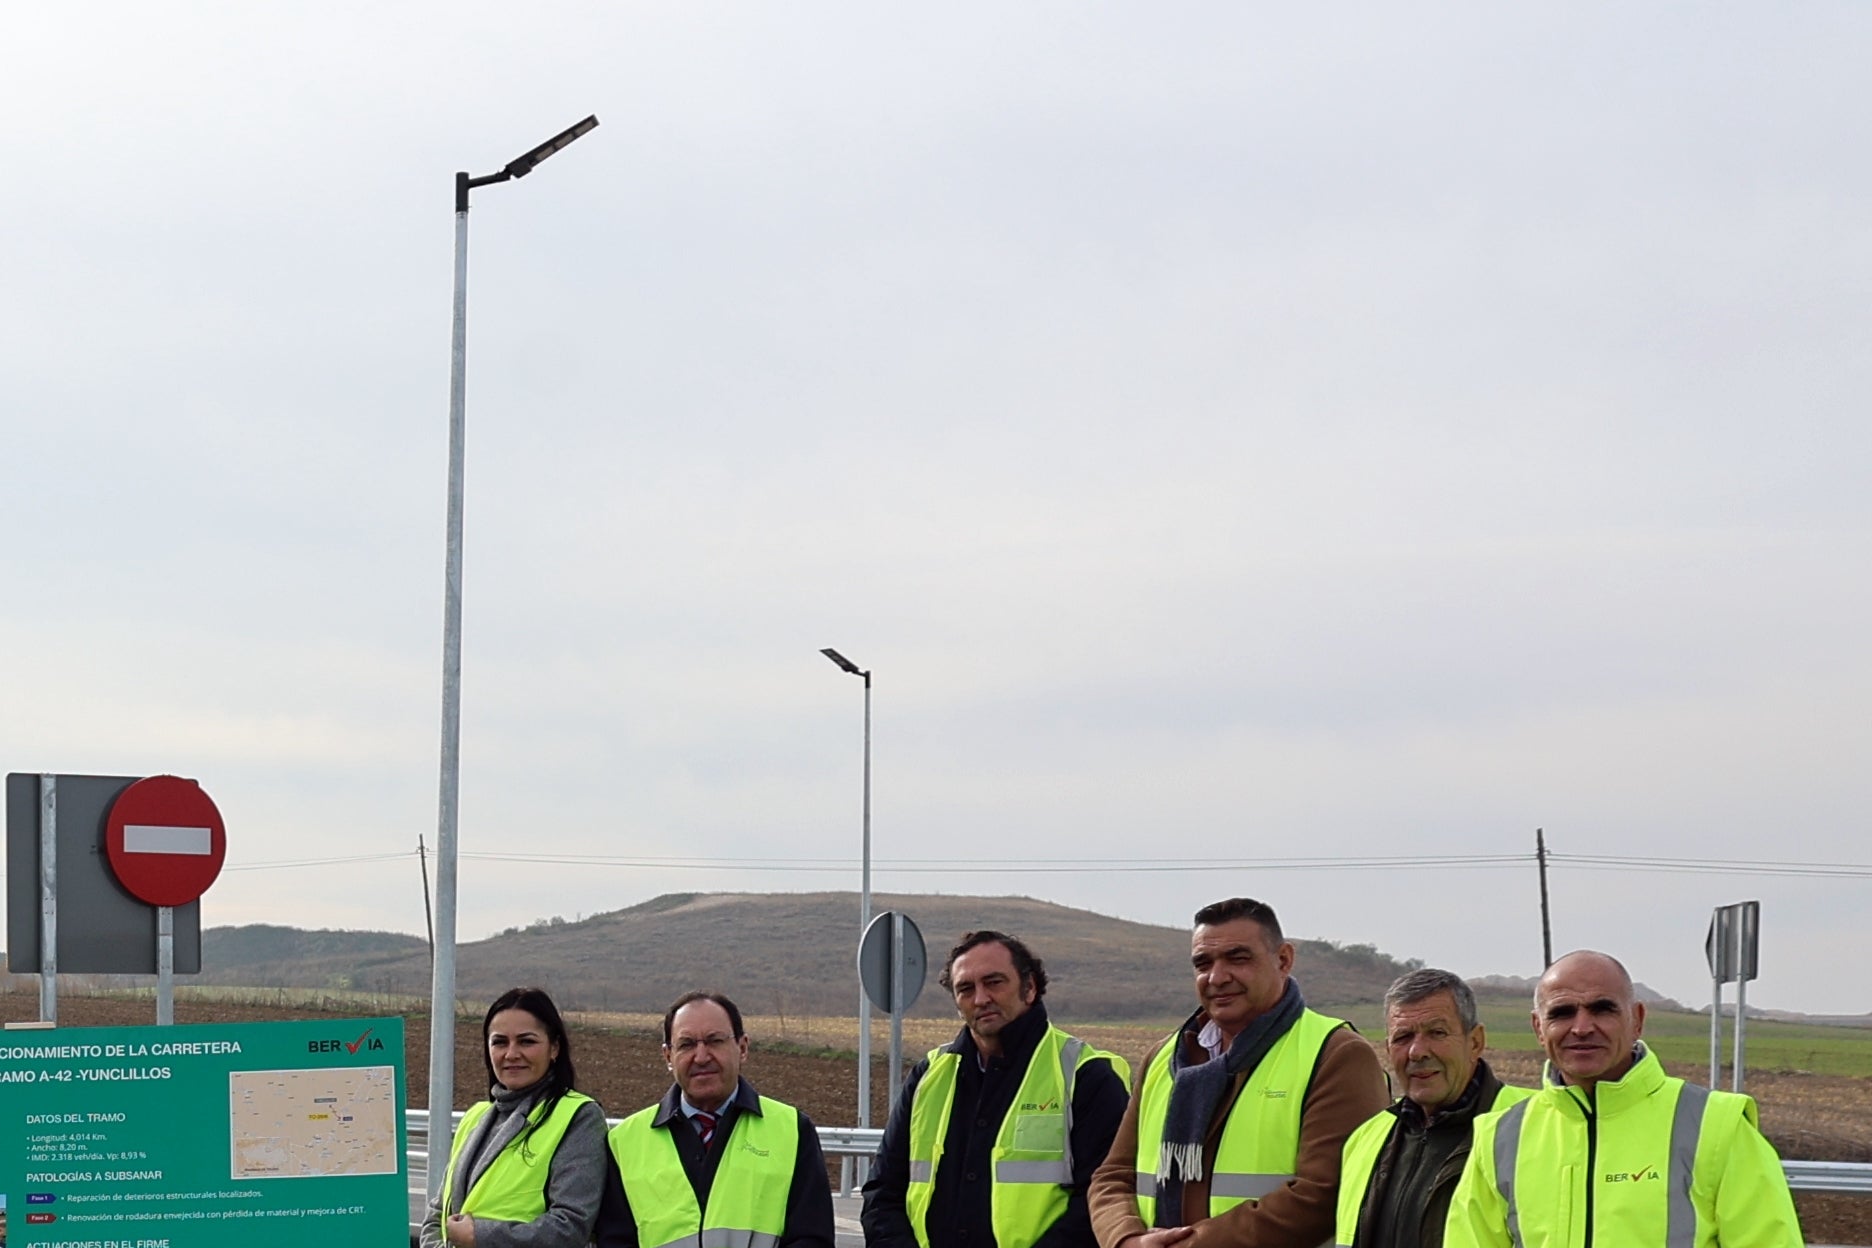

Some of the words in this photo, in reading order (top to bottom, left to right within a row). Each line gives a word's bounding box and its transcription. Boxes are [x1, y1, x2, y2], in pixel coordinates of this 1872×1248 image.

[105, 1044, 125, 1056] DE
[128, 1044, 147, 1056] LA
[151, 1041, 241, 1055] CARRETERA
[39, 1069, 72, 1081] A-42
[26, 1114, 61, 1124] DATOS
[63, 1113, 84, 1123] DEL
[87, 1112, 125, 1122] TRAMO
[26, 1169, 92, 1182] PATOLOGÍAS
[94, 1171, 102, 1180] A
[104, 1170, 162, 1180] SUBSANAR
[66, 1193, 110, 1204] Reparación
[124, 1192, 164, 1200] deterioros
[166, 1191, 217, 1199] estructurales
[67, 1213, 112, 1221] Renovación
[125, 1212, 162, 1220] rodadura
[163, 1210, 204, 1221] envejecida
[222, 1209, 253, 1220] pérdida
[266, 1208, 299, 1216] material
[306, 1208, 335, 1218] mejora
[136, 1239, 169, 1248] FIRME
